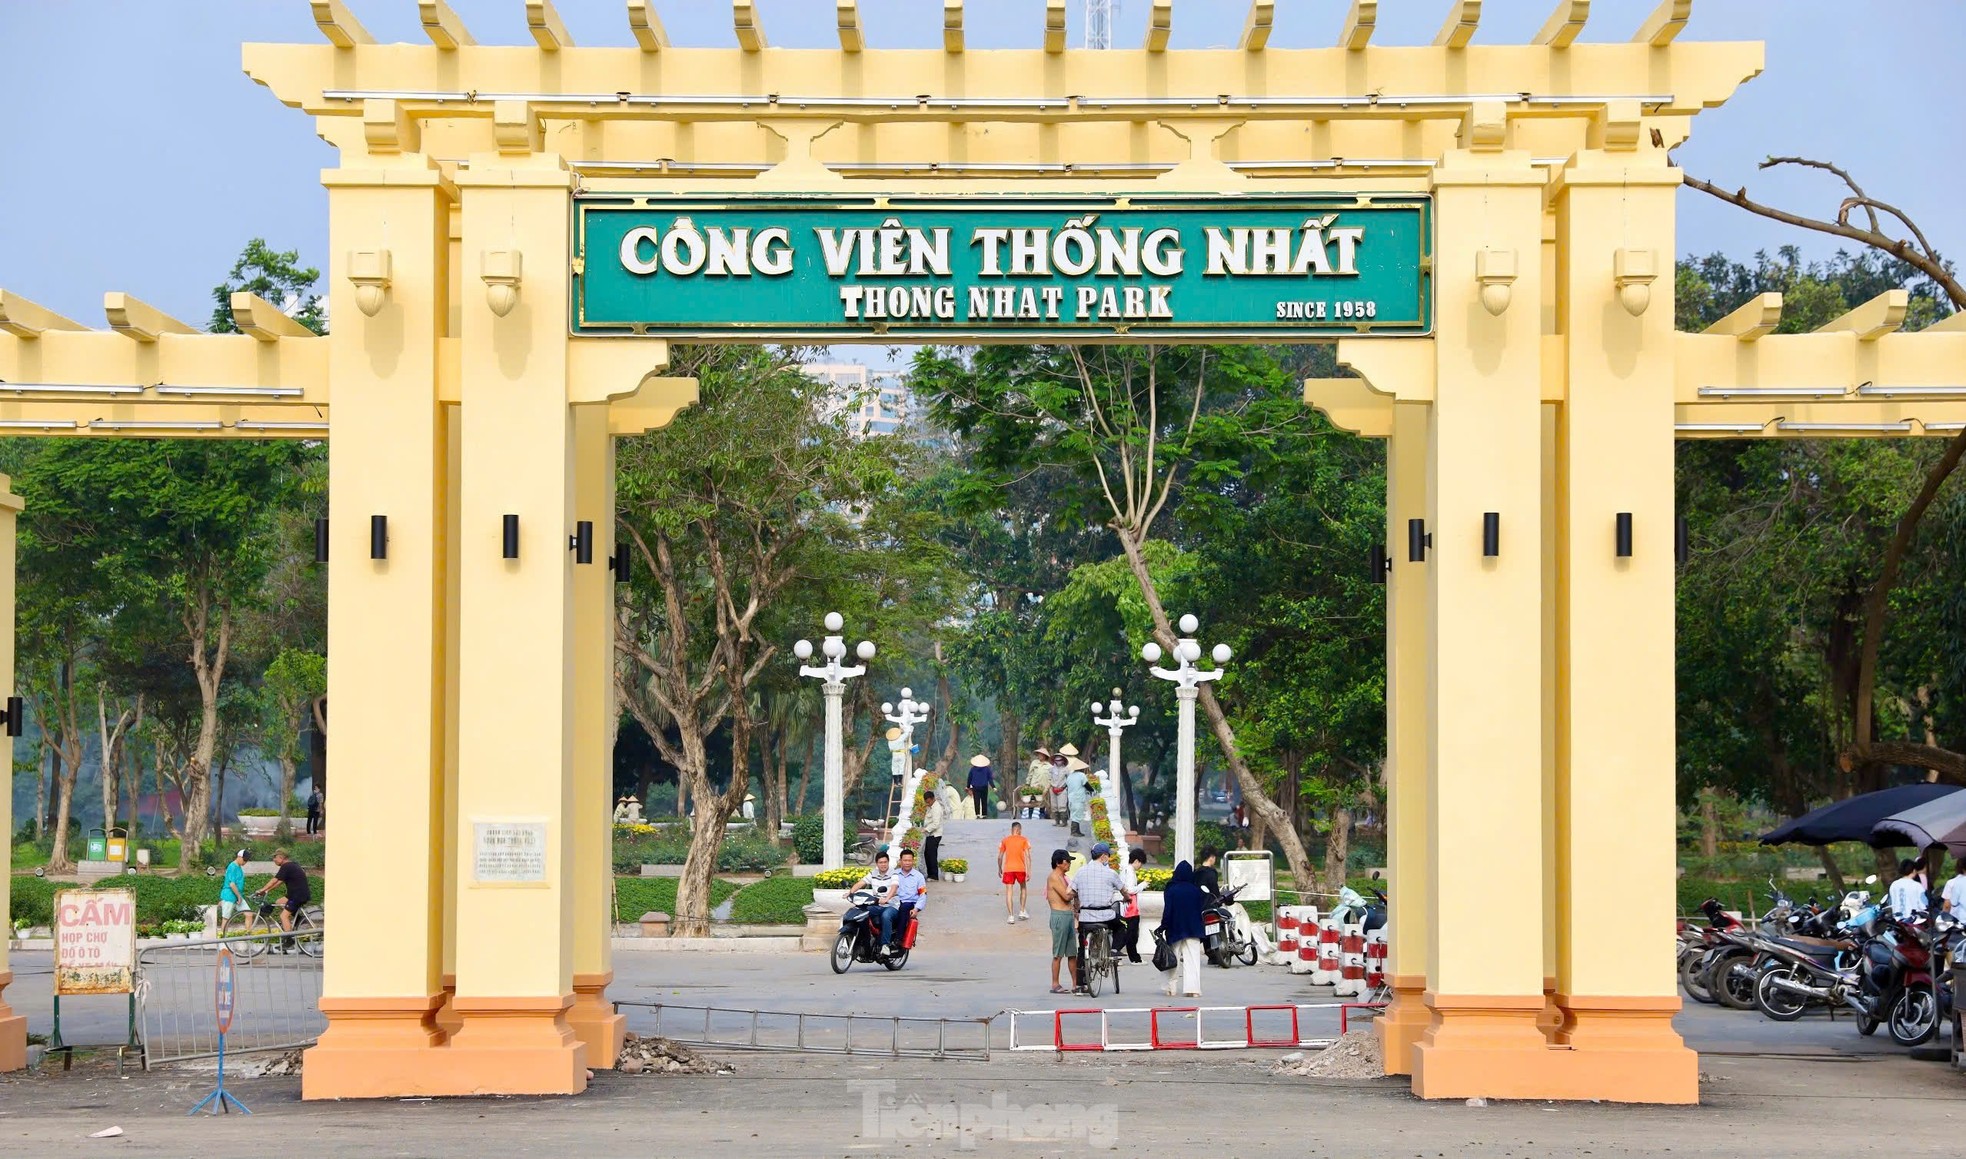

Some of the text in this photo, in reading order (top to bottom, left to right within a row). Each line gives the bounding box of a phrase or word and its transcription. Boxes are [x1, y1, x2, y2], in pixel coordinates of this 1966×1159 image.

[619, 213, 1364, 276] CÔNG VIÊN THỐNG NHẤT
[840, 284, 1174, 319] THONG NHAT PARK
[1275, 300, 1377, 319] SINCE 1958
[60, 897, 131, 927] CẤM
